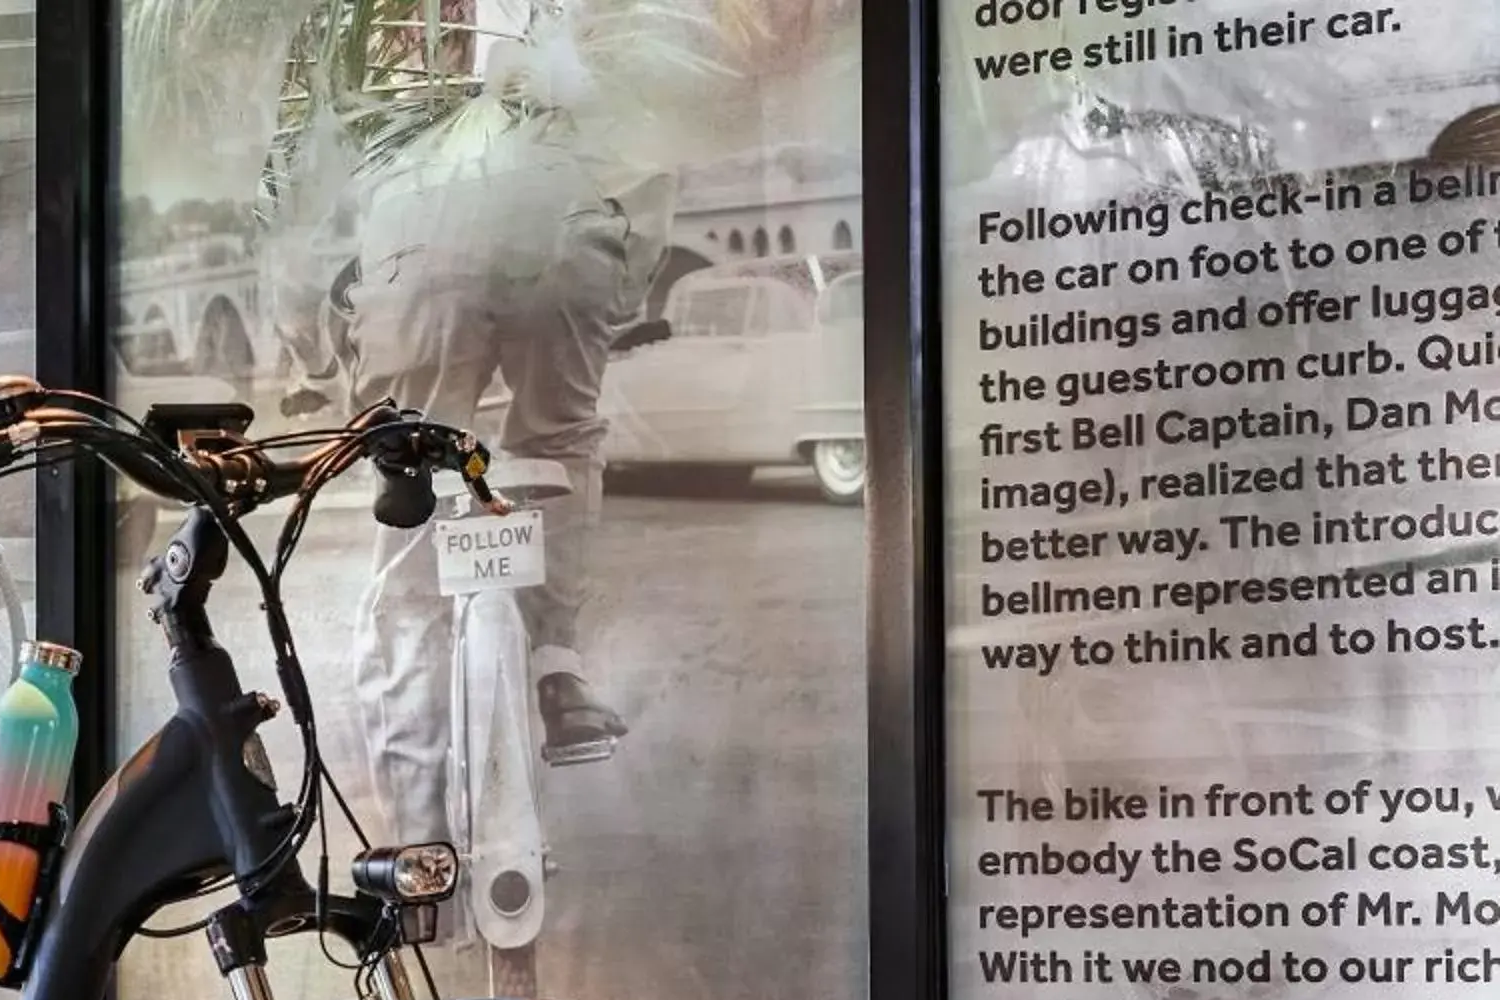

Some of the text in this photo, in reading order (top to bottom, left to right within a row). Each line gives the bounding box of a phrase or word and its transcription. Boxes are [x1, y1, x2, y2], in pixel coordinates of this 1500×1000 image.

[975, 0, 1063, 28] door
[974, 7, 1401, 81] were still in their car.
[978, 166, 1500, 246] Following check-in a bell
[977, 263, 1045, 299] the
[1055, 261, 1119, 291] car
[1128, 251, 1178, 285] on
[1188, 241, 1280, 279] foot
[1287, 238, 1335, 270] to
[1345, 233, 1427, 265] one
[1437, 218, 1488, 257] of
[979, 284, 1500, 351] buildings and offer lugga
[979, 331, 1500, 407] the guestroom curb. Qui
[979, 421, 1063, 457] first
[1072, 413, 1145, 451] Bell
[1155, 402, 1334, 450] Captain,
[1346, 397, 1431, 432] Dan
[981, 447, 1500, 515] image), realized that the
[447, 525, 533, 554] FOLLOW
[981, 528, 1109, 563] better
[1117, 527, 1210, 562] way.
[1219, 515, 1301, 550] The
[474, 557, 511, 579] ME
[981, 580, 1141, 617] bellmen
[1152, 565, 1414, 615] represented
[1426, 560, 1477, 595] an
[981, 617, 1499, 677] way to think and to host.
[976, 789, 1054, 823] The
[1065, 786, 1149, 821] bike
[1159, 785, 1195, 819] in
[1203, 783, 1315, 817] front
[1324, 779, 1373, 815] of
[1379, 787, 1473, 823] you,
[977, 841, 1143, 883] embody
[1151, 839, 1222, 875] the
[1232, 836, 1356, 873] SoCal
[979, 893, 1289, 938] representation
[1301, 891, 1349, 928] of
[1357, 891, 1421, 927] Mr.
[978, 950, 1073, 984] With
[1083, 950, 1114, 984] it
[1121, 957, 1182, 984] we
[1193, 949, 1271, 985] nod
[1281, 951, 1329, 984] to
[1339, 957, 1414, 983] our
